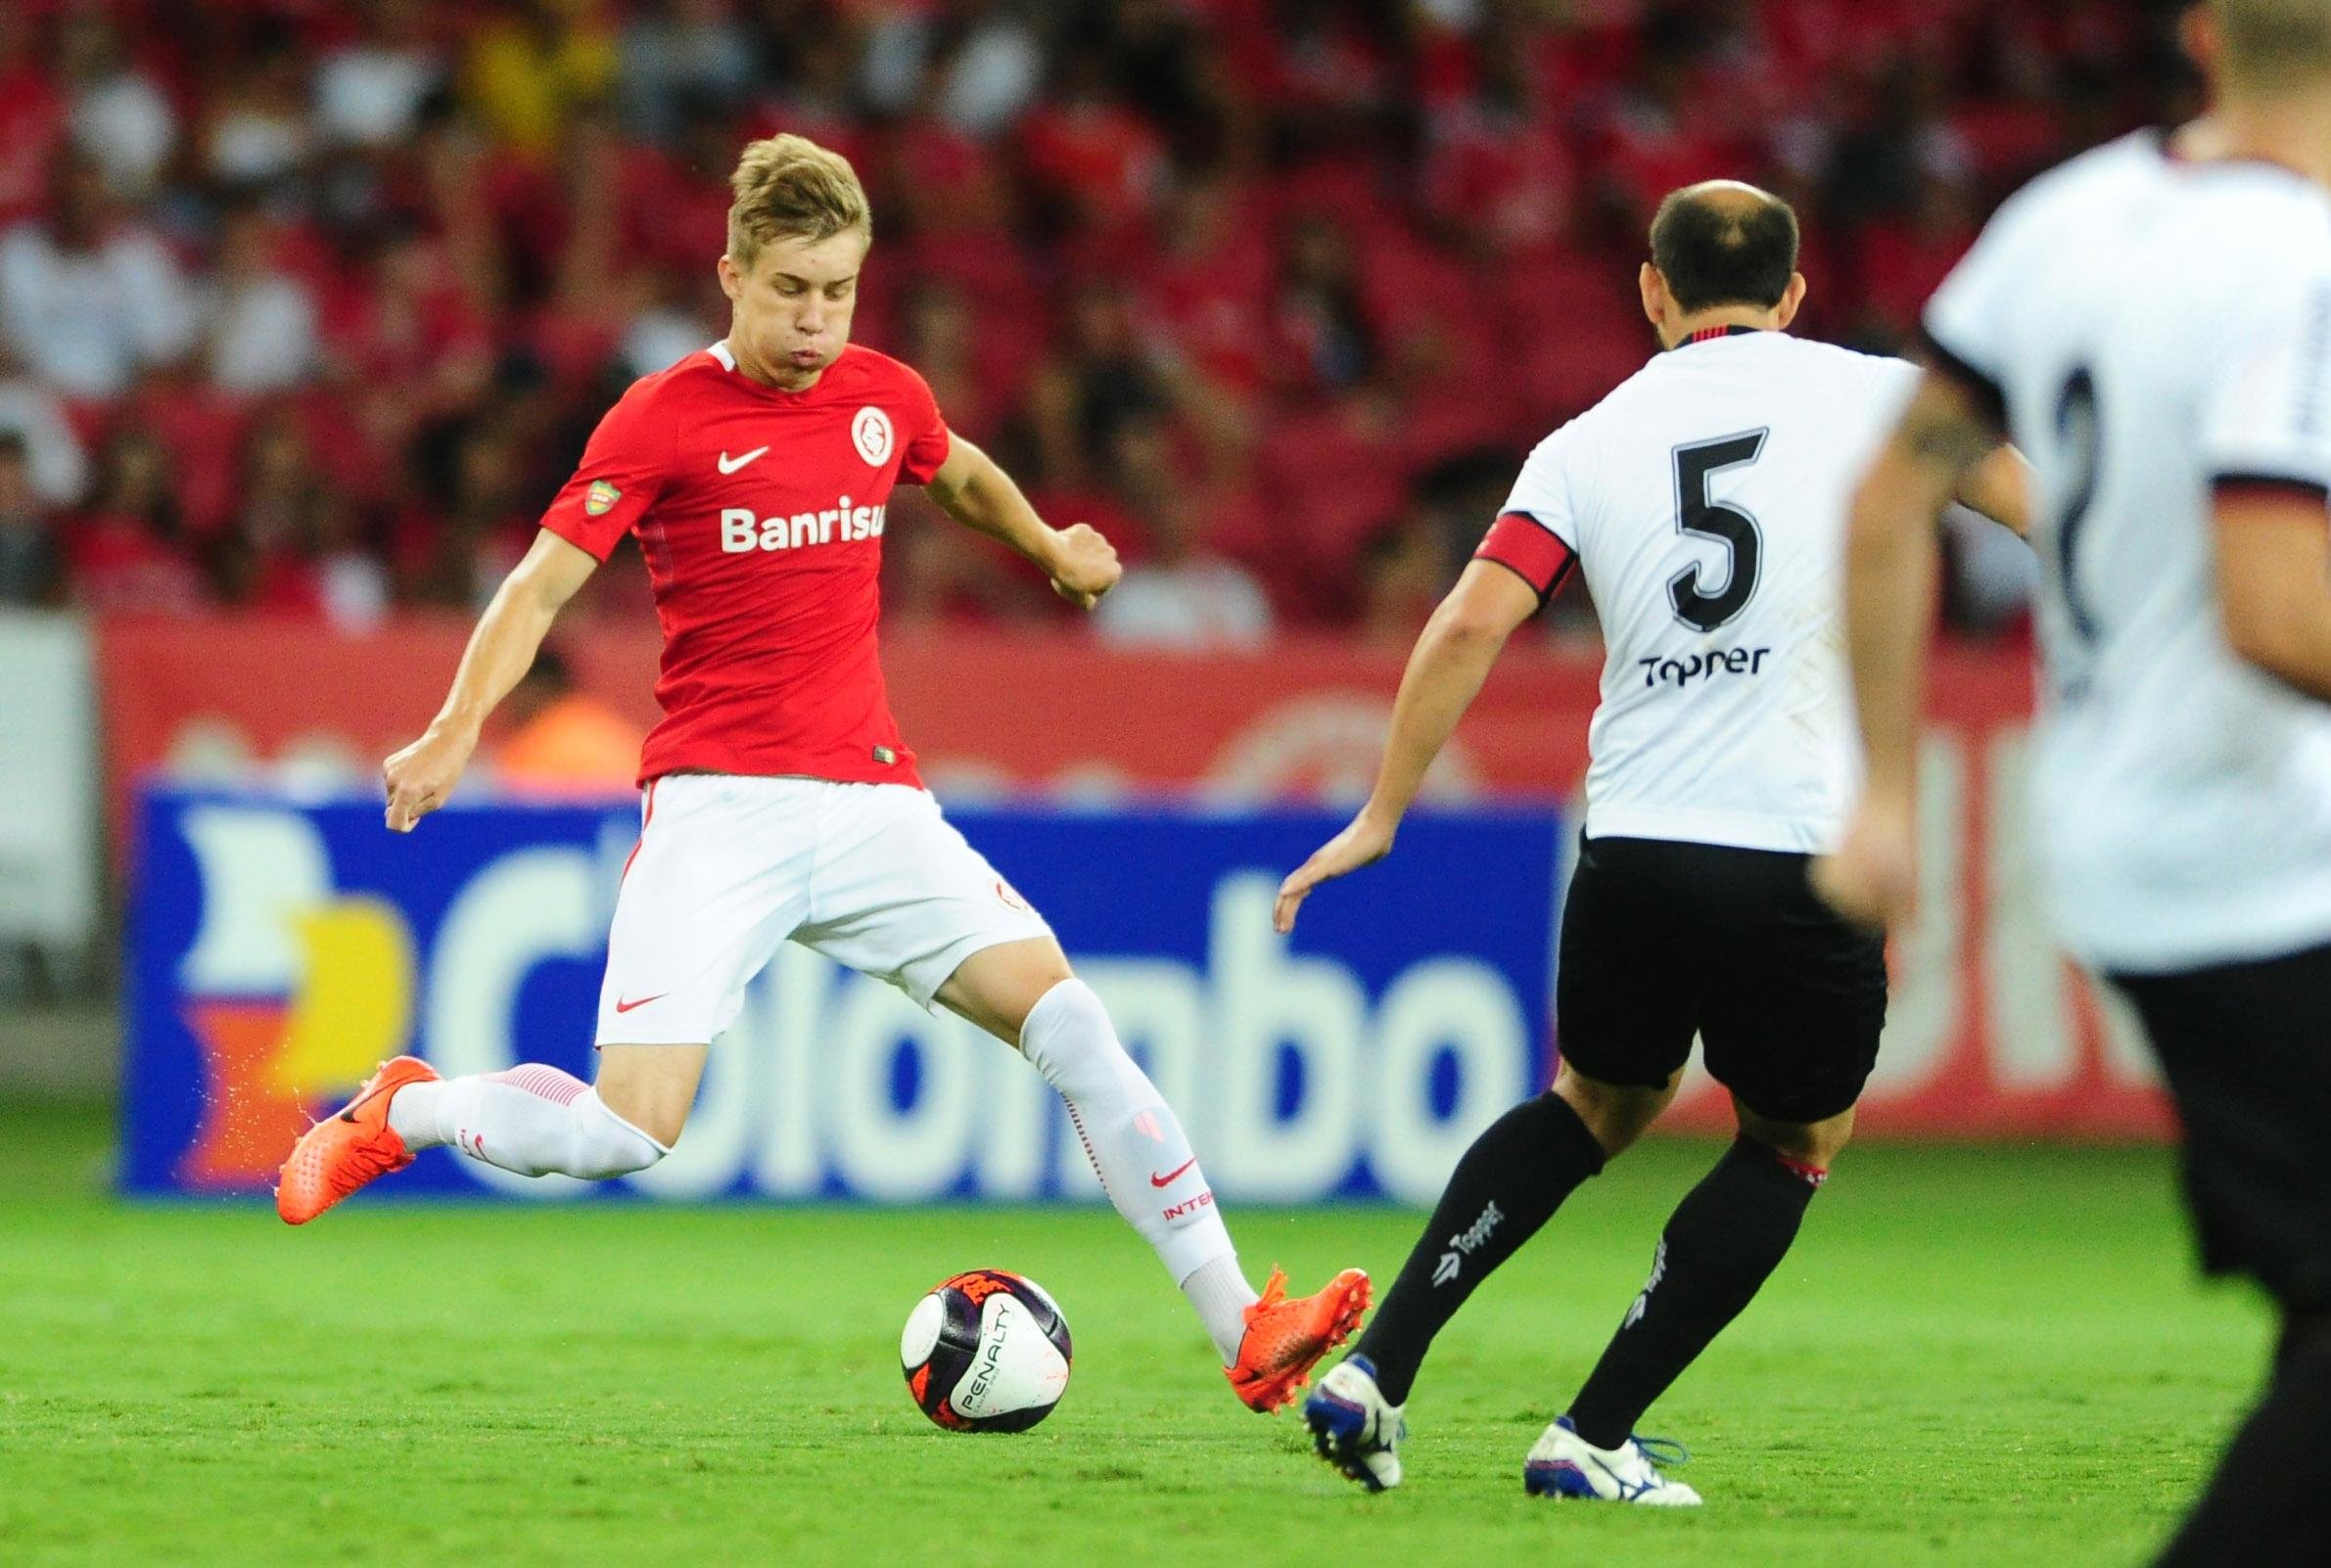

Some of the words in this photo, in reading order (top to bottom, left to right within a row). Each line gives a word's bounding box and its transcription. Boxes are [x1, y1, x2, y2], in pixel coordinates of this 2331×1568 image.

[721, 494, 886, 554] Banrisu
[1666, 426, 1770, 633] 5
[960, 1303, 1011, 1411] PENALTY
